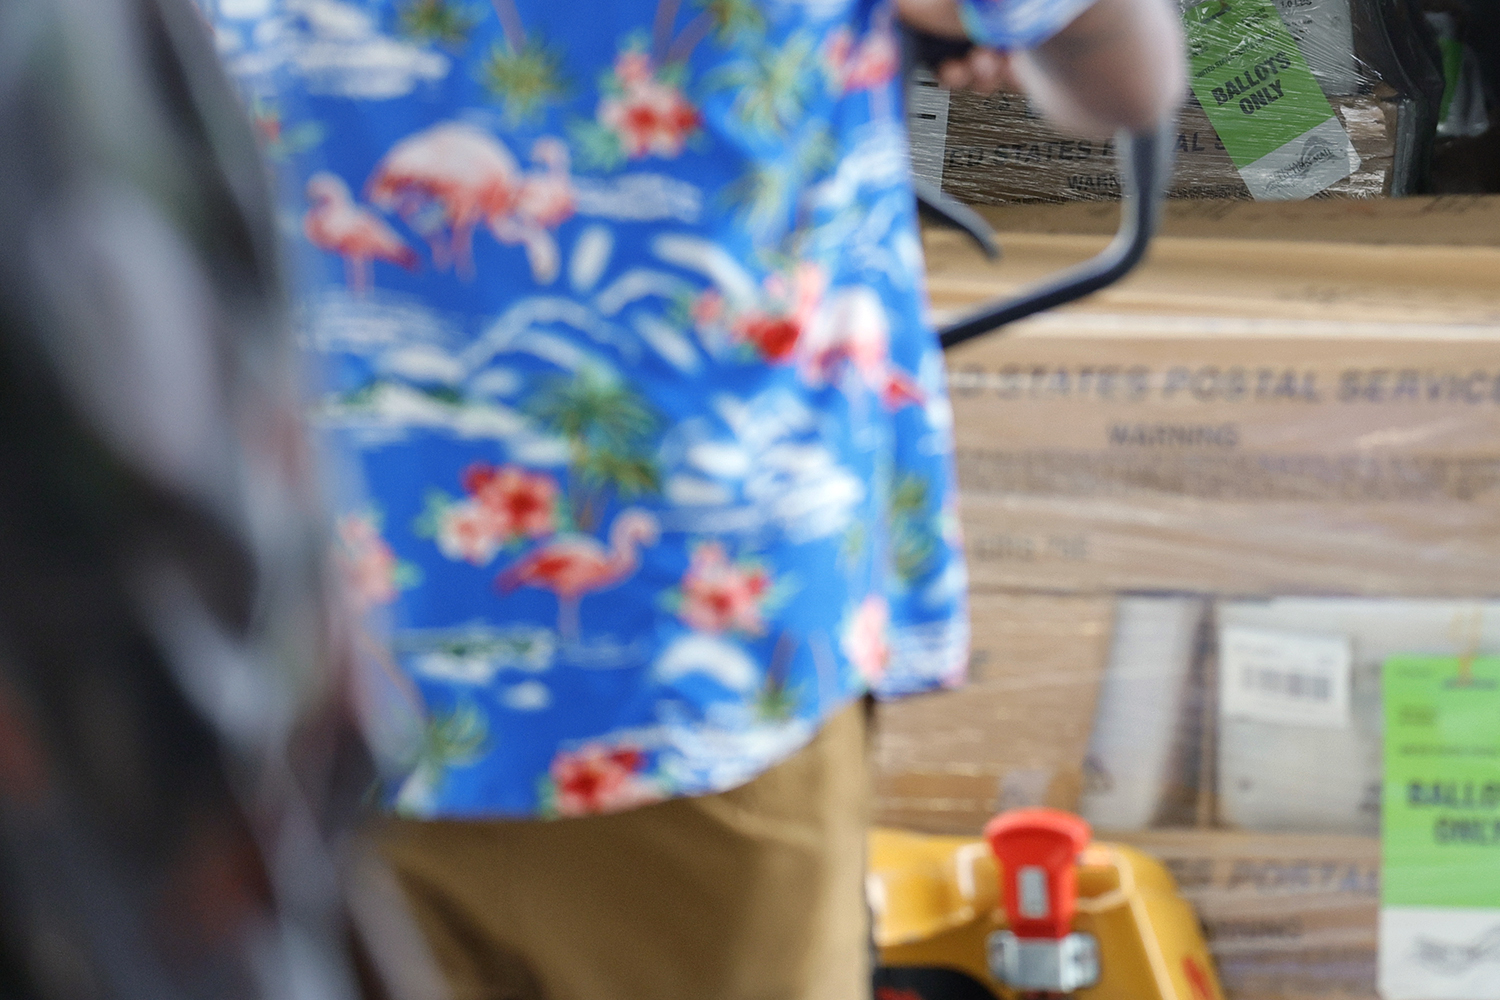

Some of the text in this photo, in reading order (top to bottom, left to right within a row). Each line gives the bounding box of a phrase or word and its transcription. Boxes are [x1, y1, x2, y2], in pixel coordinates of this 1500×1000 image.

[1211, 51, 1292, 106] BALLOTS
[1239, 79, 1285, 115] ONLY
[996, 139, 1093, 164] STATES
[996, 364, 1150, 401] STATES
[1162, 366, 1318, 402] POSTAL
[1107, 422, 1240, 448] WARNING
